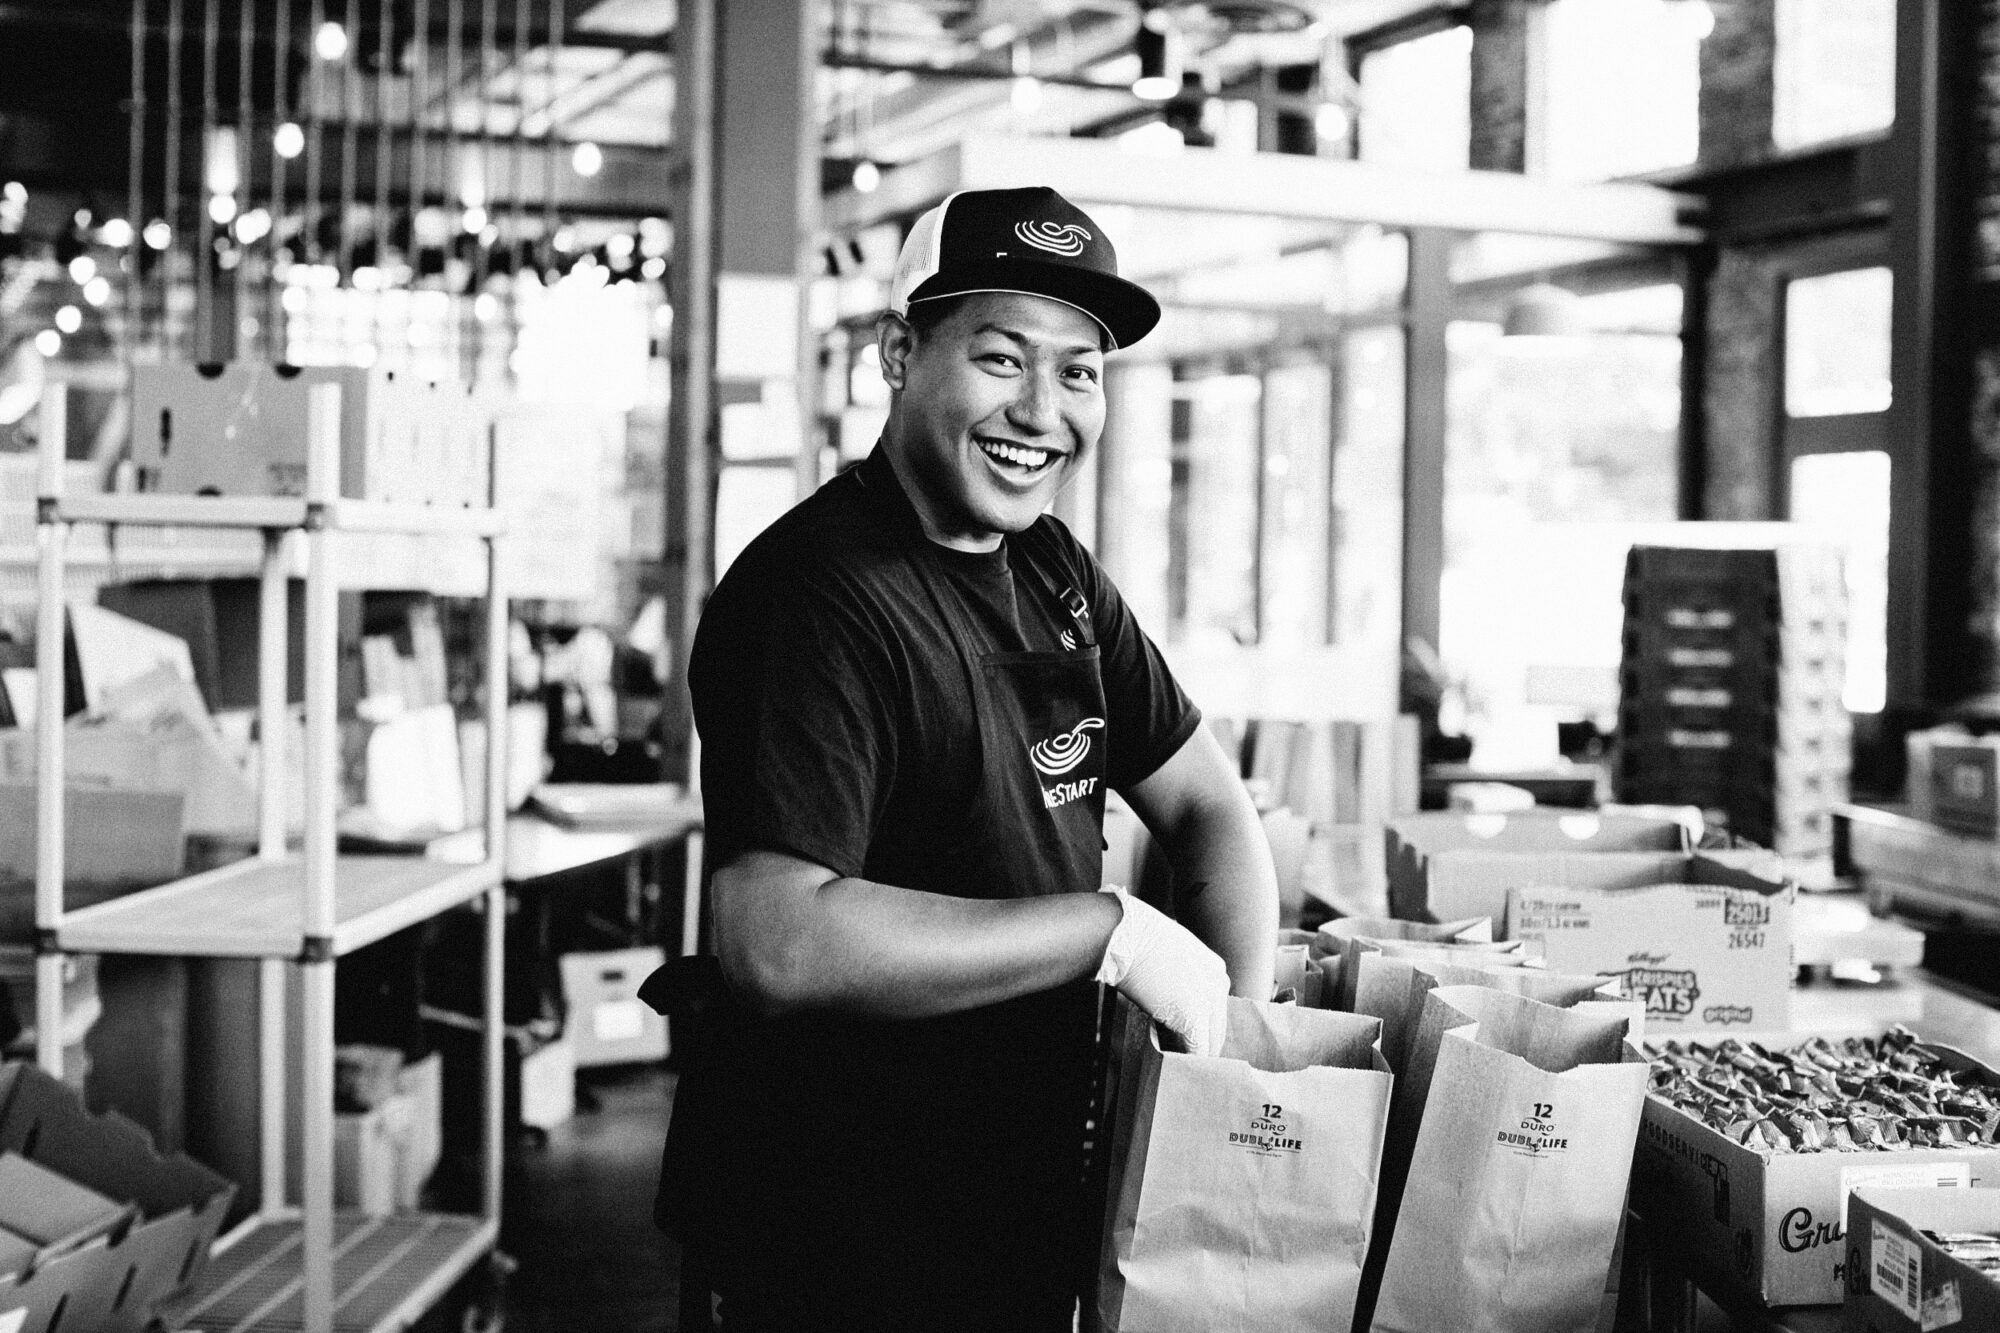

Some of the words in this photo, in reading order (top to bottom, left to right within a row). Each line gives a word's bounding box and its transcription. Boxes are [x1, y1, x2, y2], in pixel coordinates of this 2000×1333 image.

[1729, 932, 1766, 949] 26547
[1262, 1104, 1282, 1119] 12
[1534, 1103, 1553, 1118] 12
[1251, 1121, 1287, 1132] DURO
[1521, 1121, 1555, 1132] DURO
